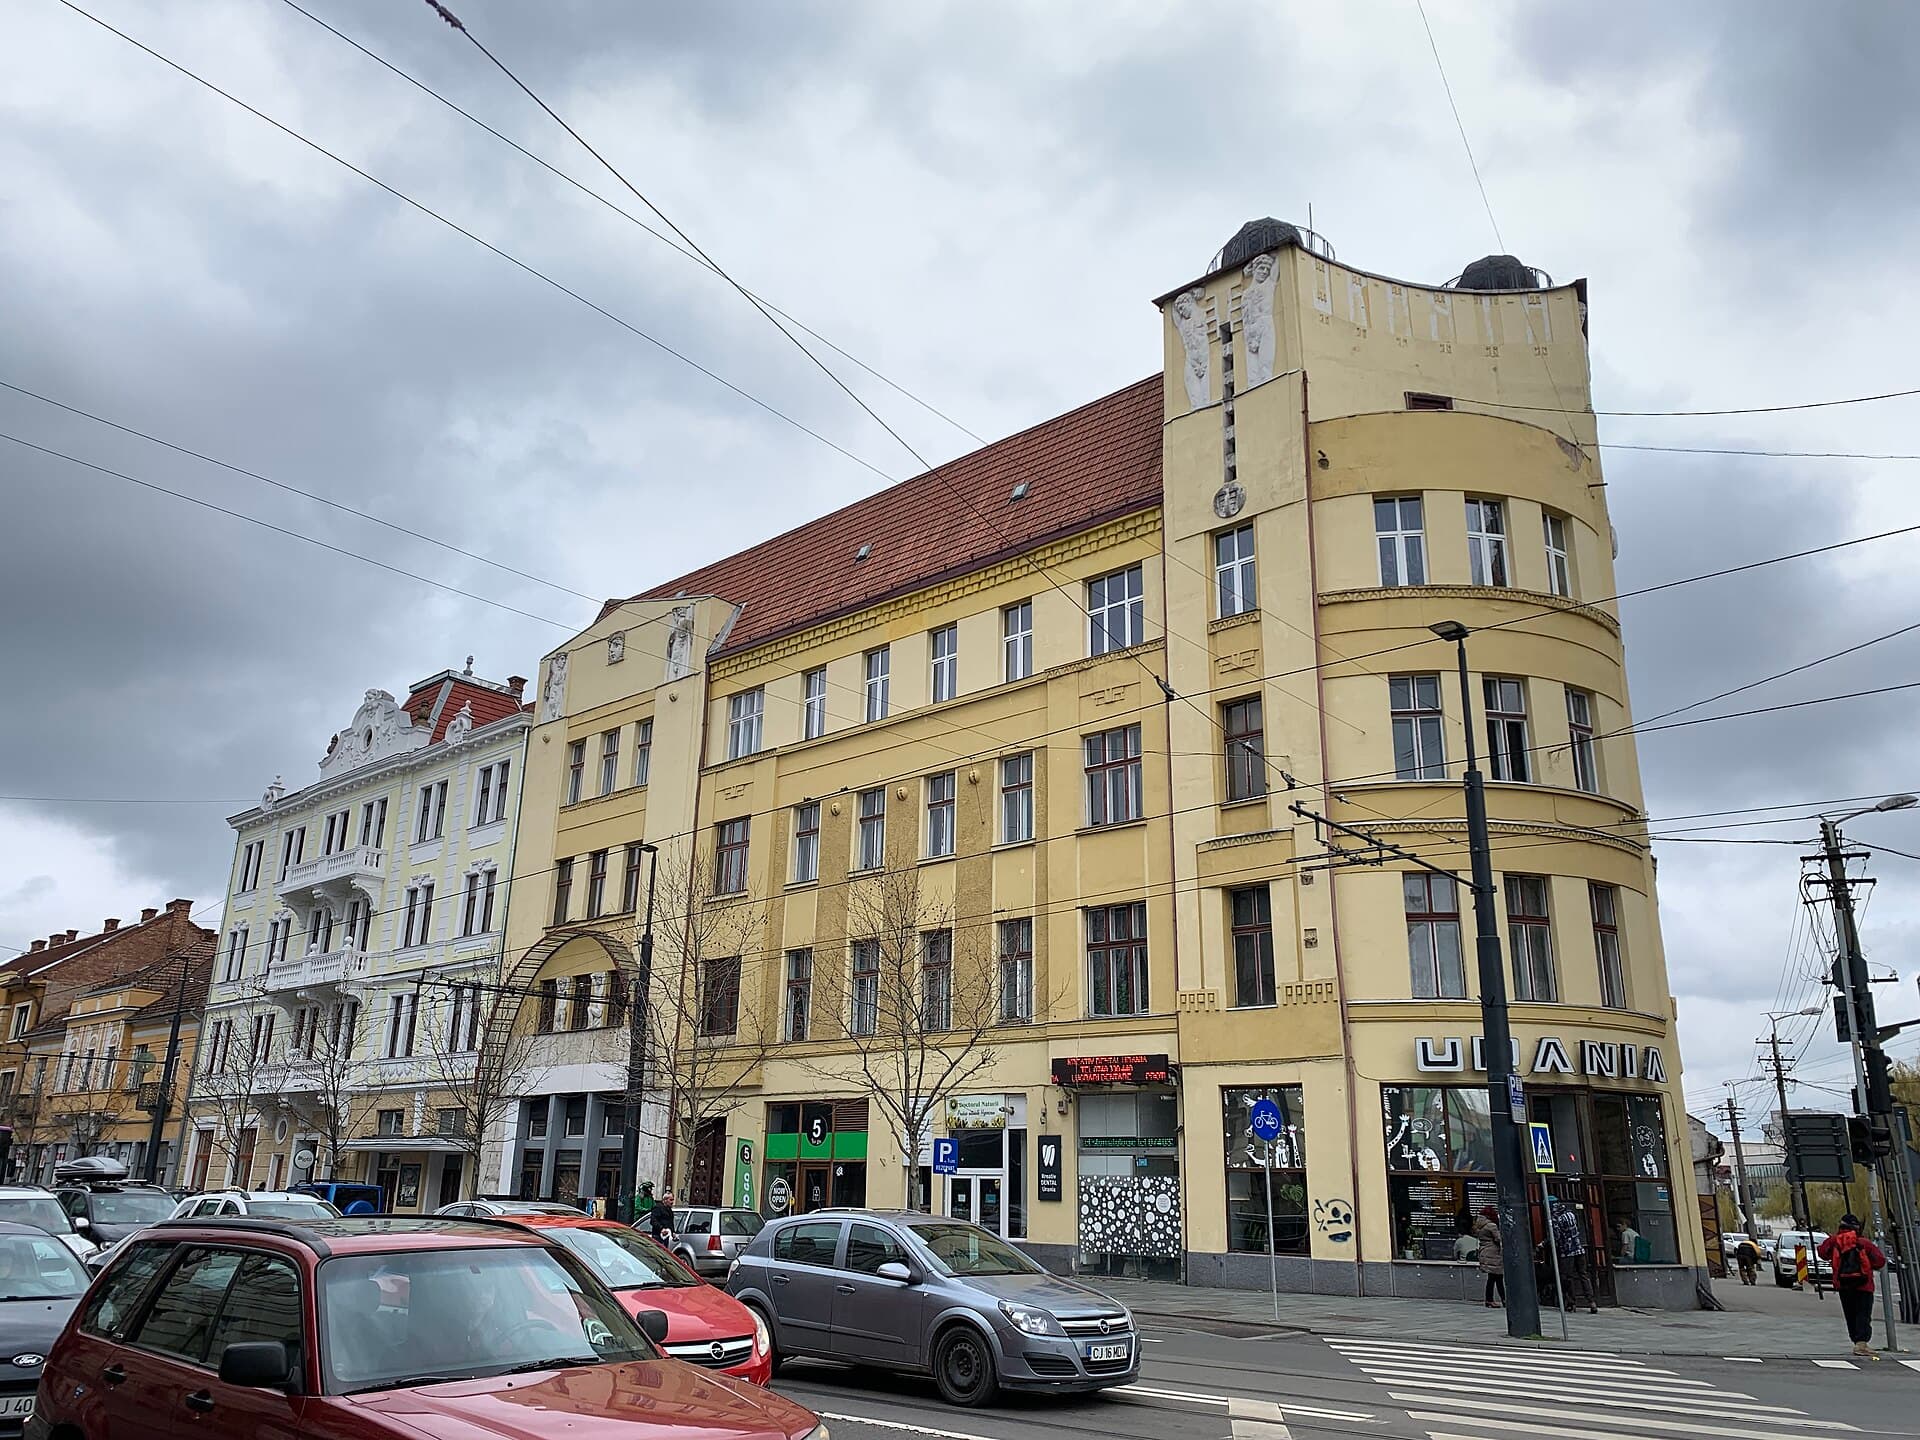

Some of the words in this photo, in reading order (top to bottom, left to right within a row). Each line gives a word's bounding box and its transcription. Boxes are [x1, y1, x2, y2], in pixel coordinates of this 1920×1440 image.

[812, 1119, 821, 1138] 5
[743, 1147, 750, 1159] 5
[939, 1142, 952, 1163] P
[772, 1195, 786, 1203] OPEN
[1093, 1347, 1104, 1359] CJ
[1105, 1347, 1112, 1359] 16
[14, 1398, 33, 1412] 40
